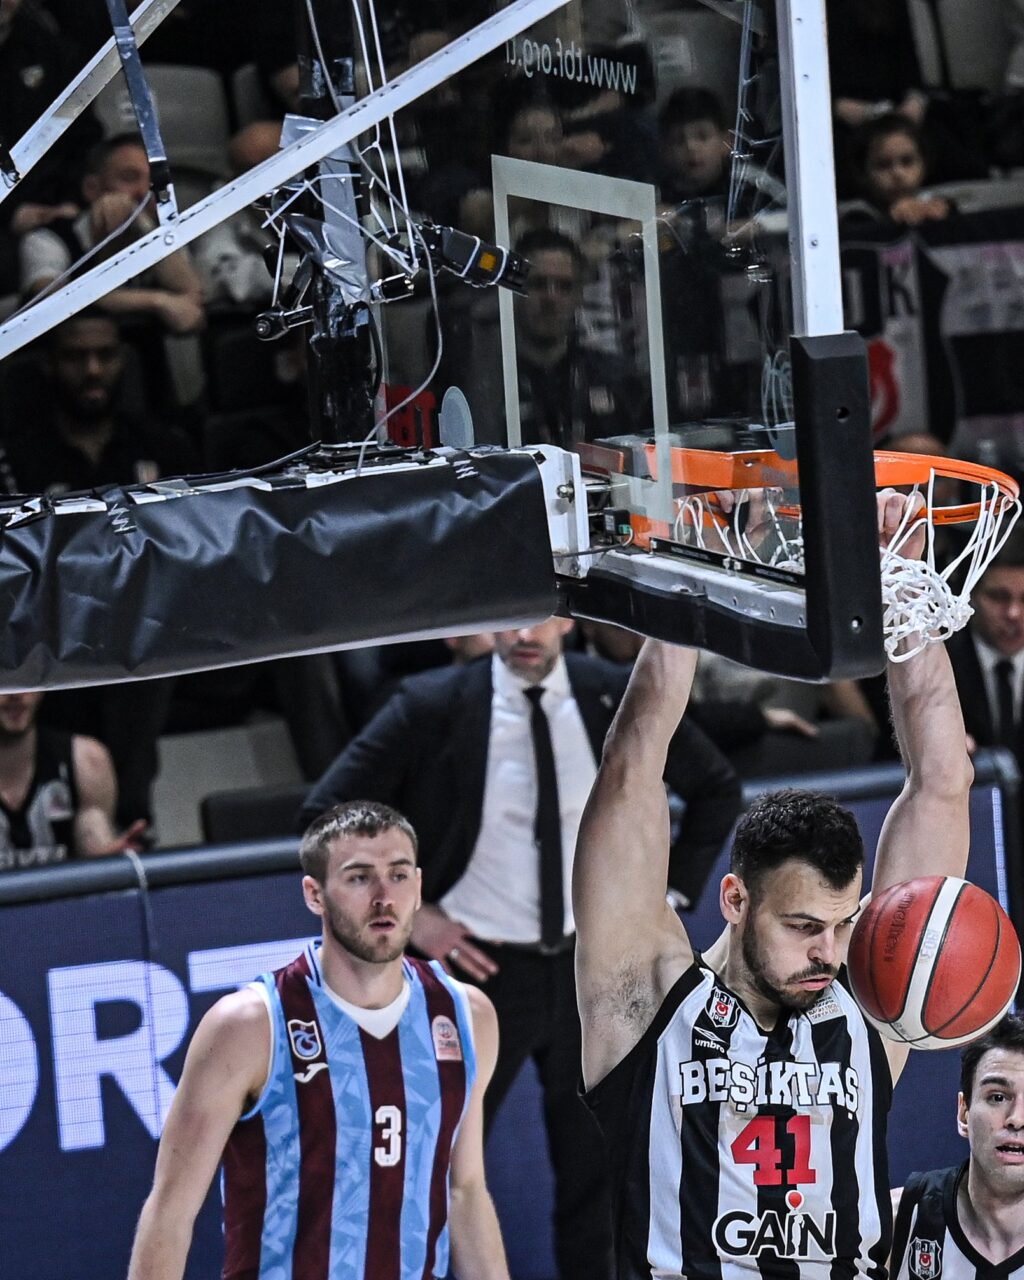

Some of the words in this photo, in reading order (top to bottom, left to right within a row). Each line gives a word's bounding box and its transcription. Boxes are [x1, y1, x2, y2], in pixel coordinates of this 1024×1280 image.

[694, 1038, 725, 1054] umbro
[679, 1056, 859, 1120] BEŞİKTAŞ
[375, 1105, 402, 1167] 3
[730, 1115, 816, 1185] 41
[712, 1208, 837, 1257] GAIN
